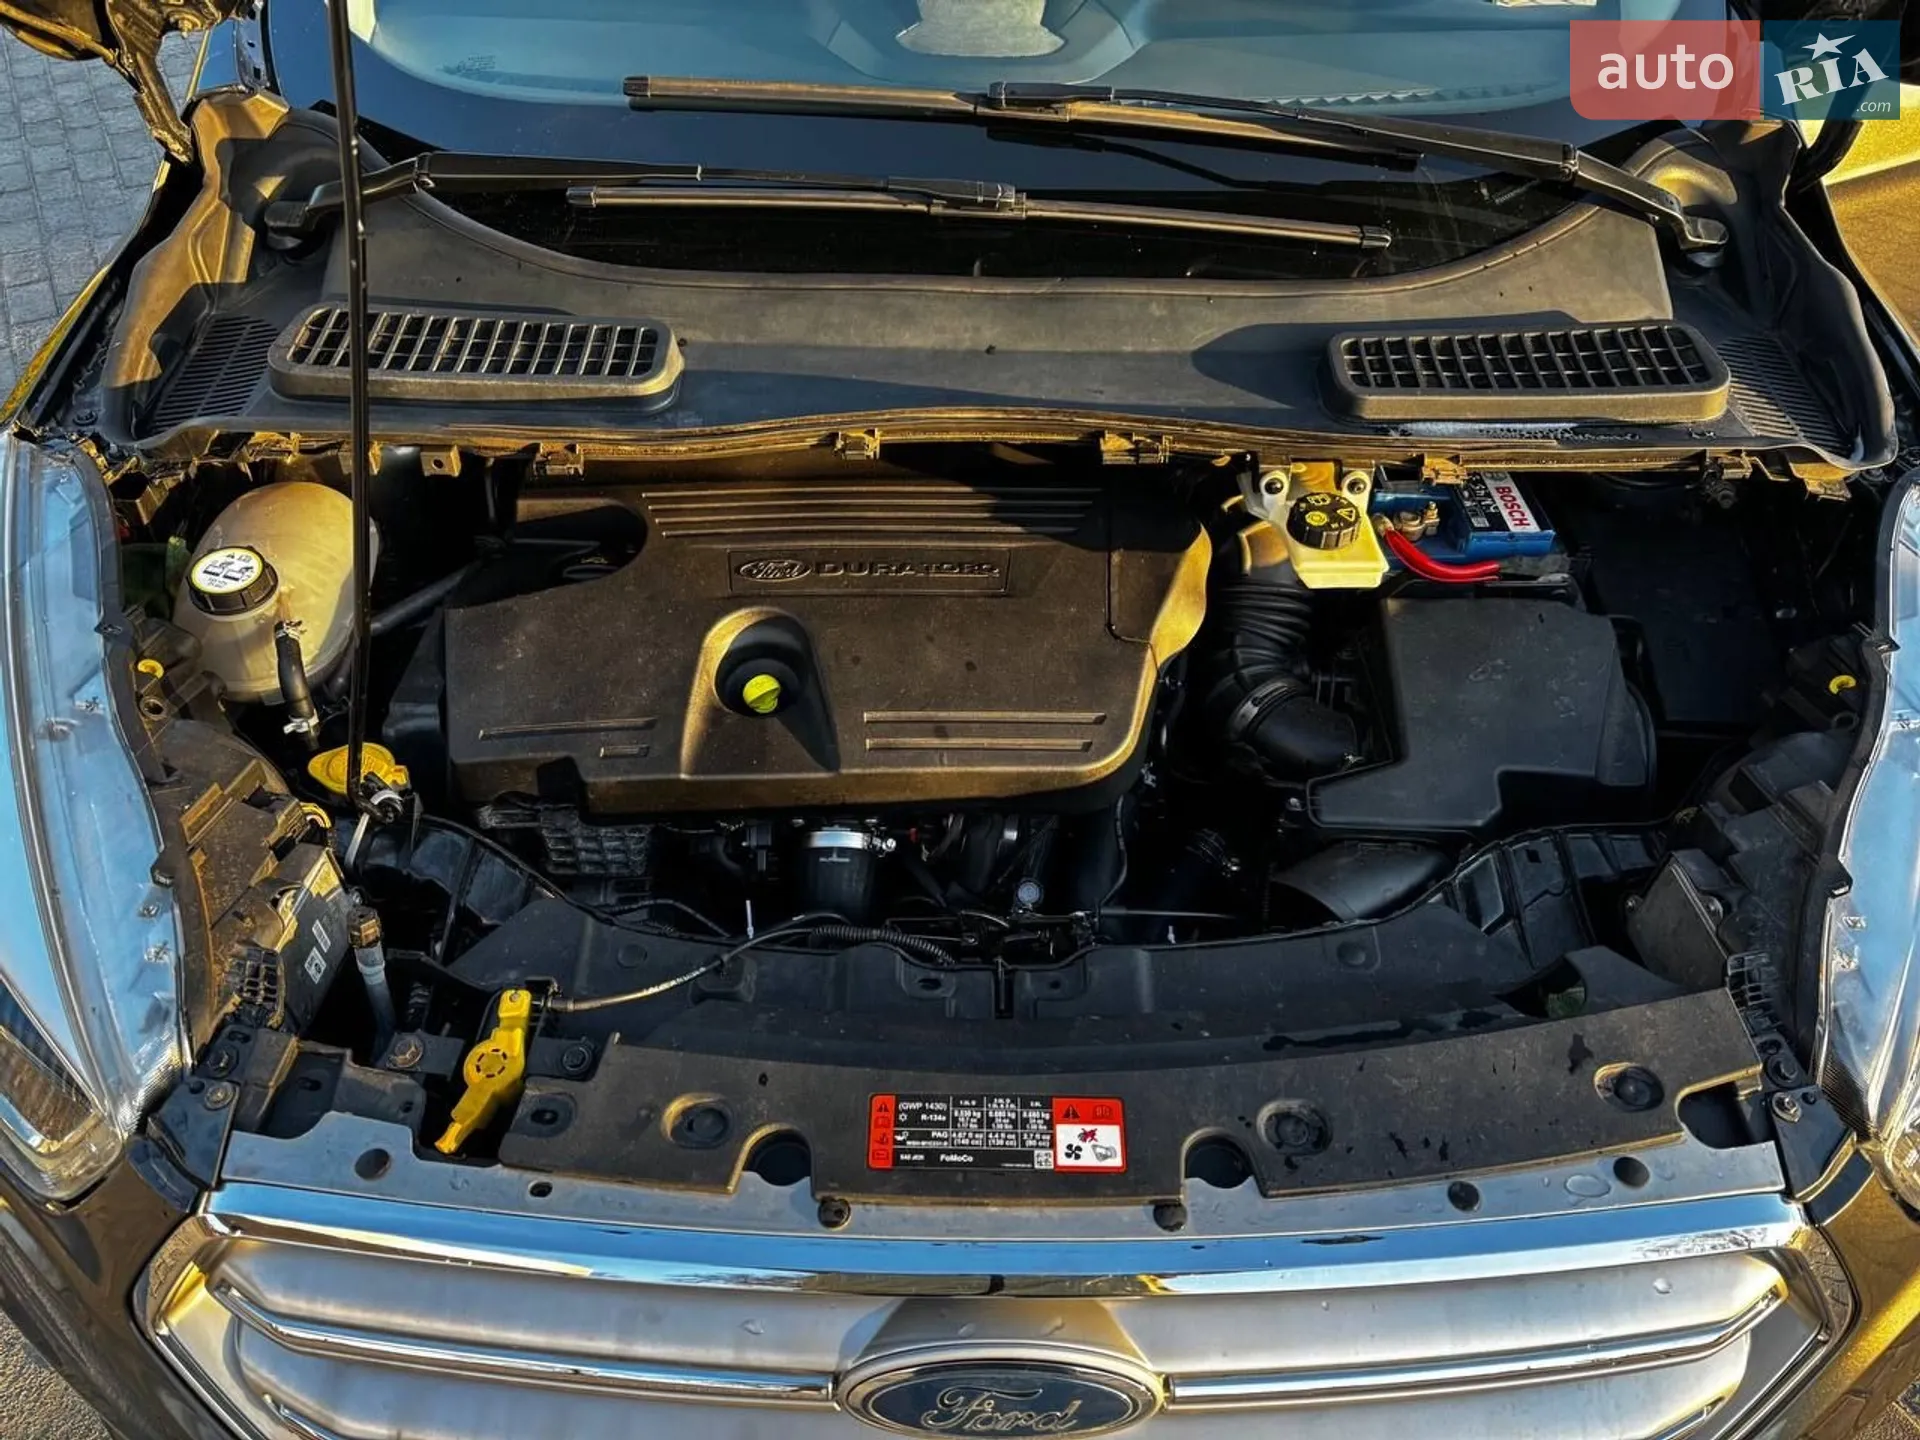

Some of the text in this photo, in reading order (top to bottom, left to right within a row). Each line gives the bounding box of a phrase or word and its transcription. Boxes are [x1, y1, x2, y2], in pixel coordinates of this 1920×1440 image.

[1494, 485, 1531, 528] BOSCH
[898, 1102, 923, 1112] (GWP
[921, 1113, 946, 1122] R-134a
[931, 1131, 948, 1139] PAG
[940, 1153, 973, 1162] FoMoCo
[919, 1385, 1084, 1431] Ford
